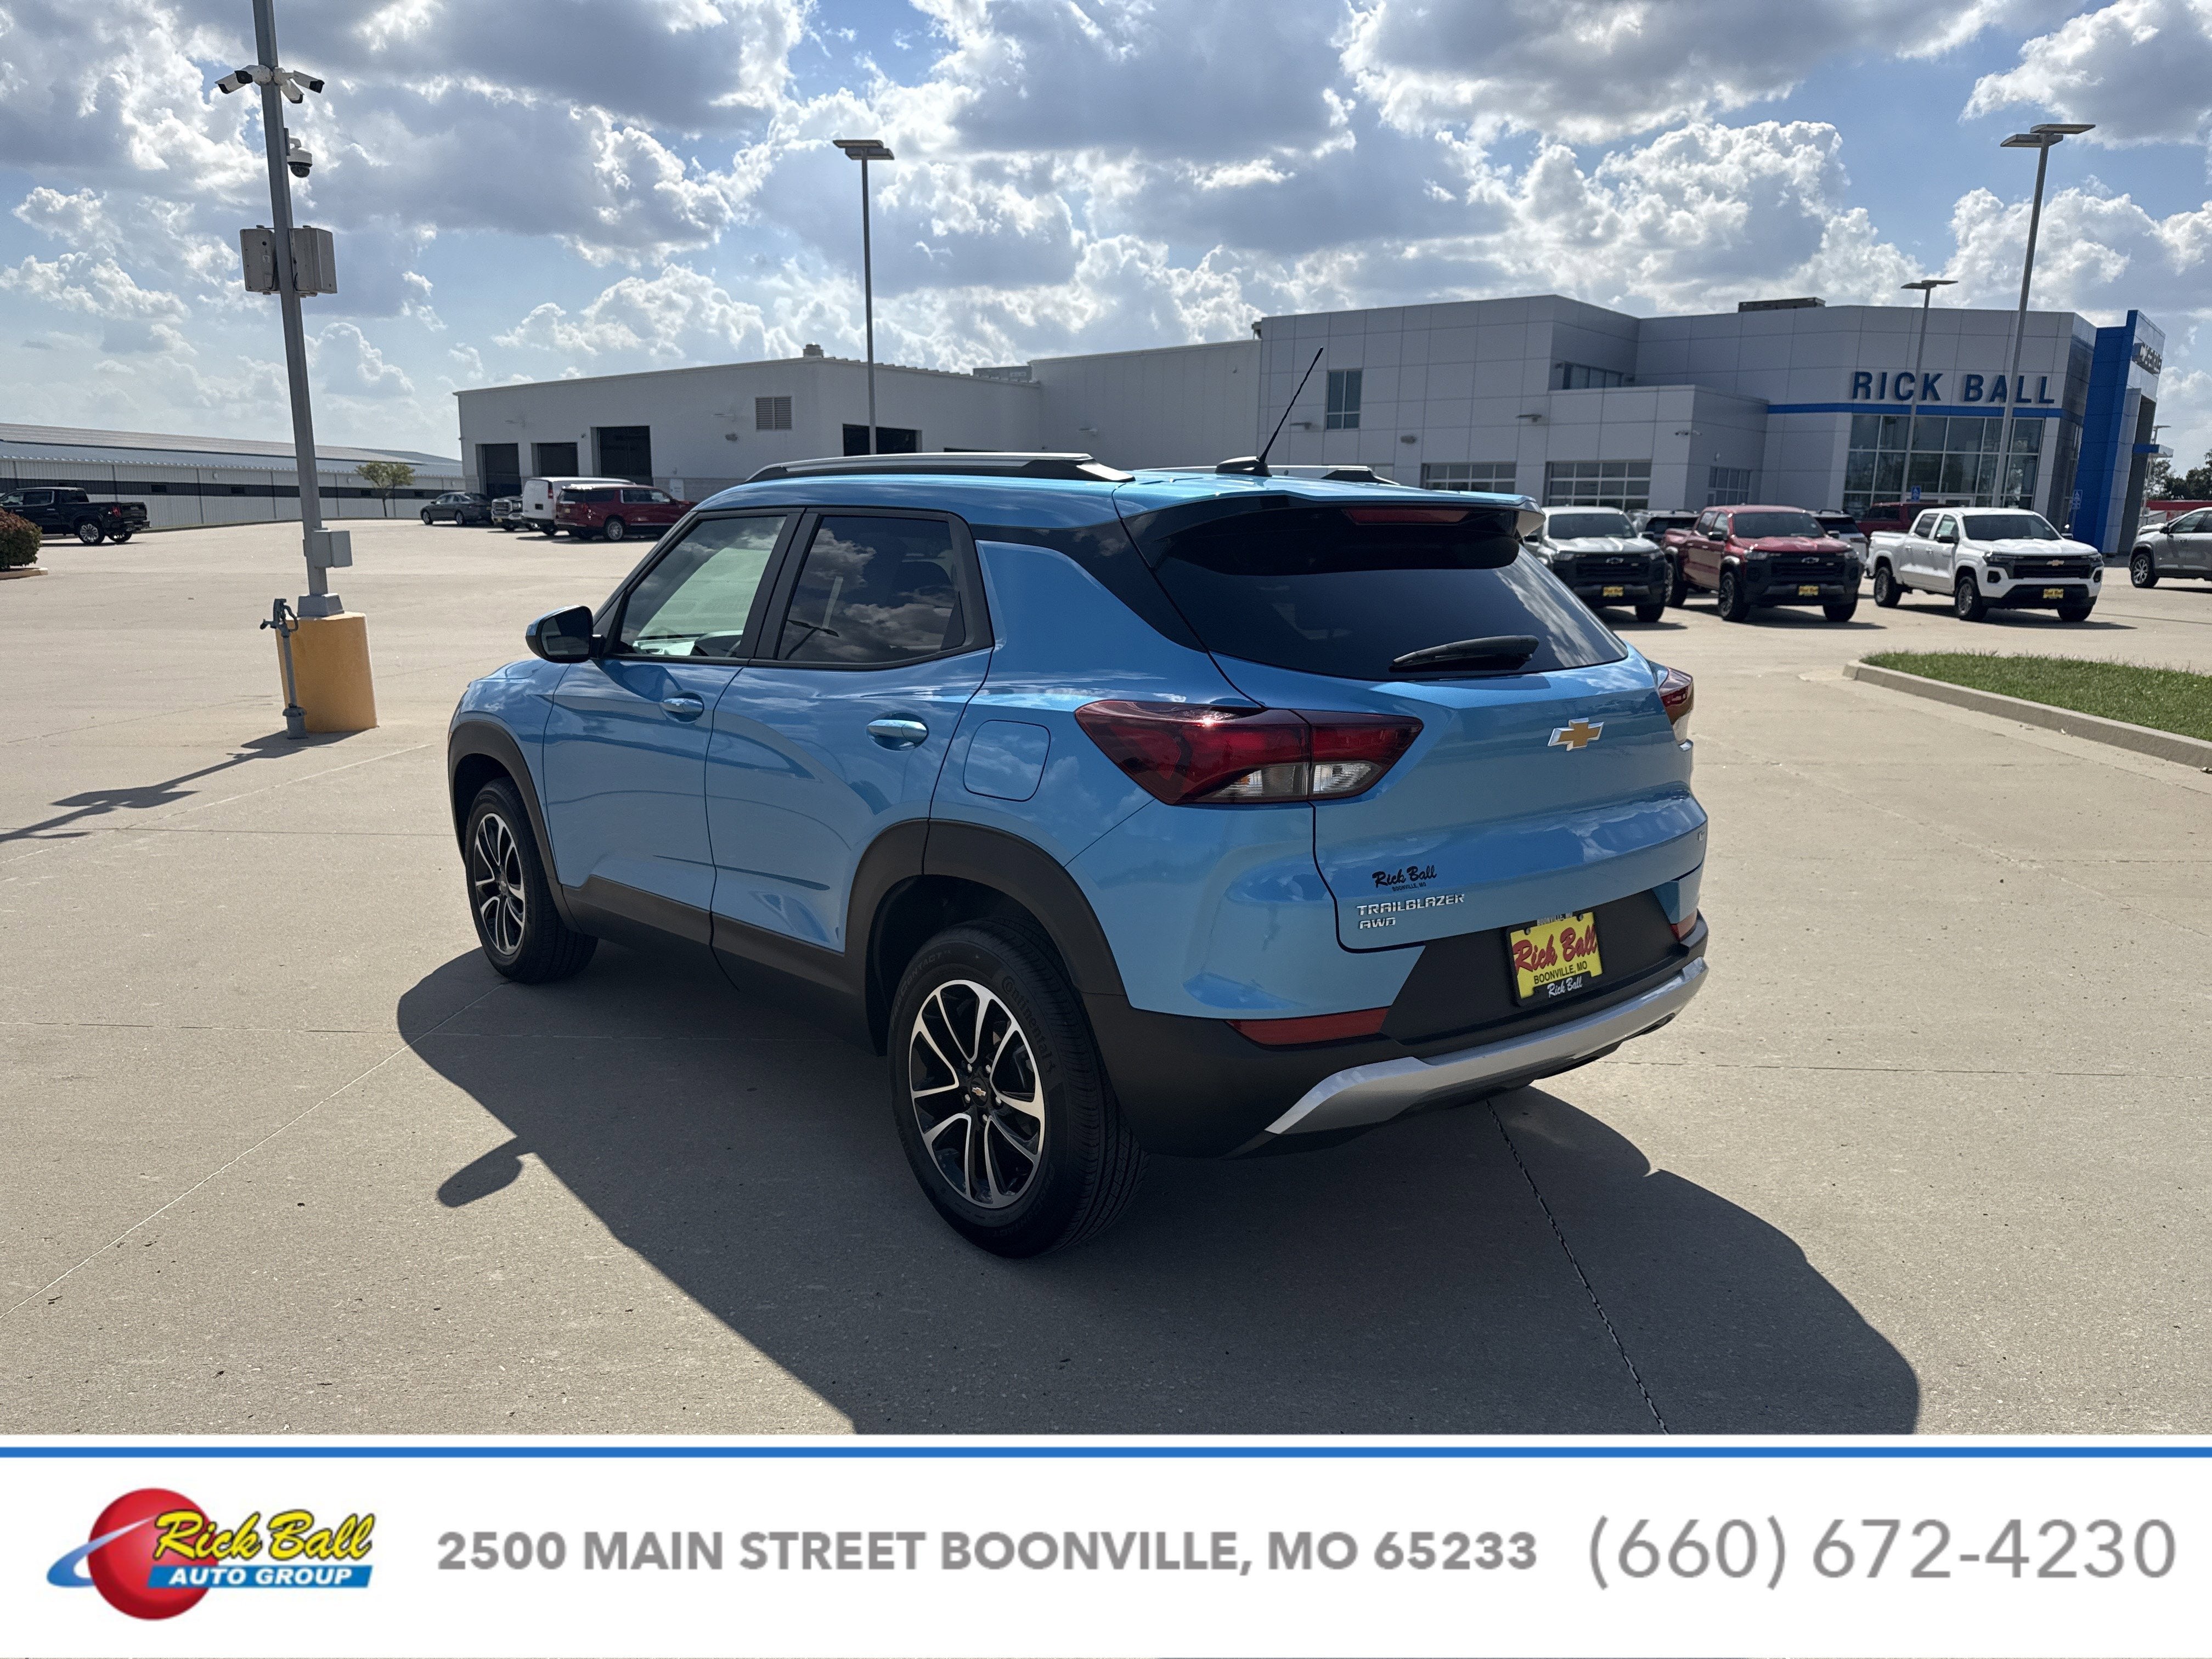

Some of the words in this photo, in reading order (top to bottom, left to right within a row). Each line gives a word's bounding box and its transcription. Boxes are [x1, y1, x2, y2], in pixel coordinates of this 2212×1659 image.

[1852, 371, 1943, 401] RICK
[1963, 374, 2055, 404] BALL
[1372, 868, 1406, 888] Rick
[1406, 865, 1437, 882] Ball
[1357, 894, 1465, 916] TRAILBLAZER
[1359, 917, 1396, 929] AWD
[1512, 934, 1558, 975] Rick
[1560, 922, 1597, 962] Ball
[1533, 964, 1576, 984] BOONVILLE,
[1577, 960, 1588, 972] MO
[1547, 980, 1565, 998] Rick
[1565, 975, 1583, 991] Ball
[1002, 975, 1053, 1060] Continental
